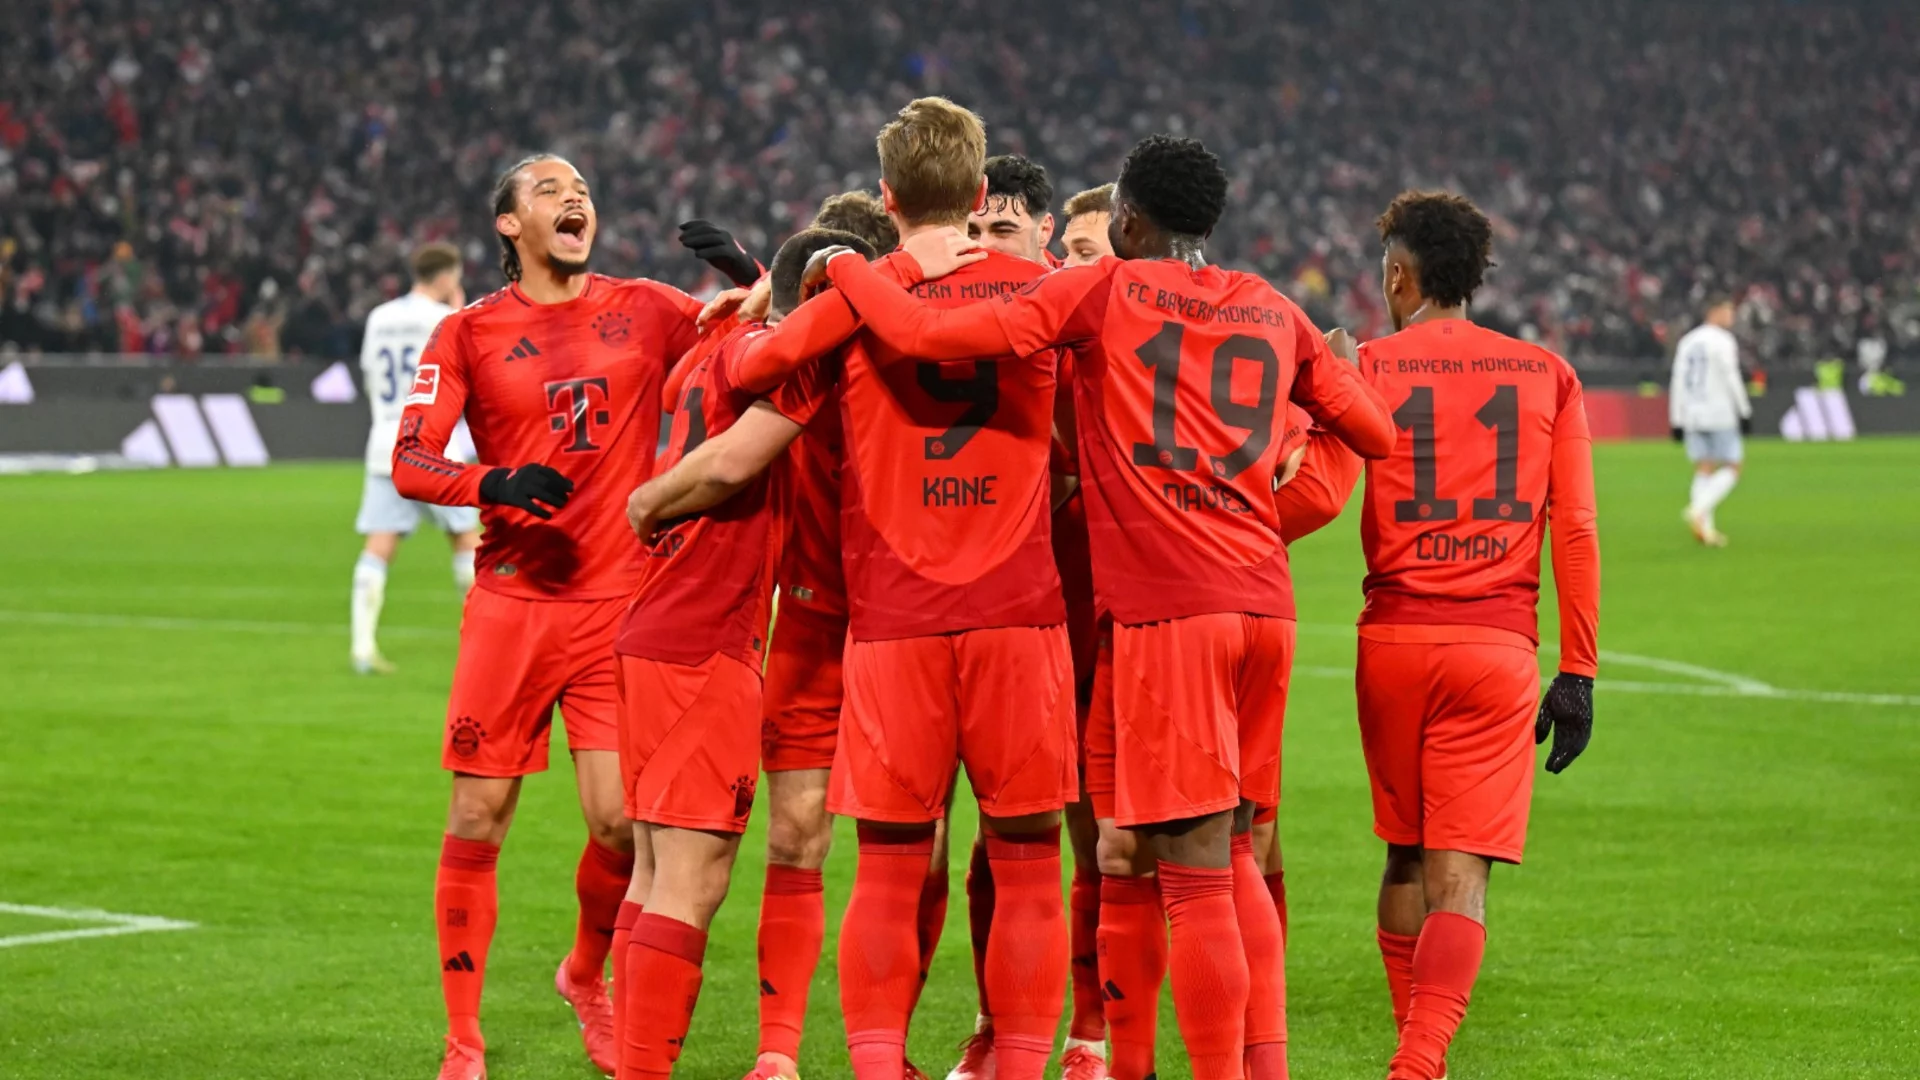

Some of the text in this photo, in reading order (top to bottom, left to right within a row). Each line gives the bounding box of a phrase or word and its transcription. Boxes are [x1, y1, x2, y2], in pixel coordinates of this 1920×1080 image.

[911, 281, 951, 299] ERN
[1127, 282, 1285, 328] FC BAYERN MÜNCHEN
[1373, 357, 1548, 374] FC BAYERN MÜNCHEN
[916, 359, 998, 461] 9
[1133, 320, 1280, 481] 19
[1392, 384, 1534, 523] 11
[922, 475, 998, 507] KANE
[1416, 532, 1508, 562] COMAN
